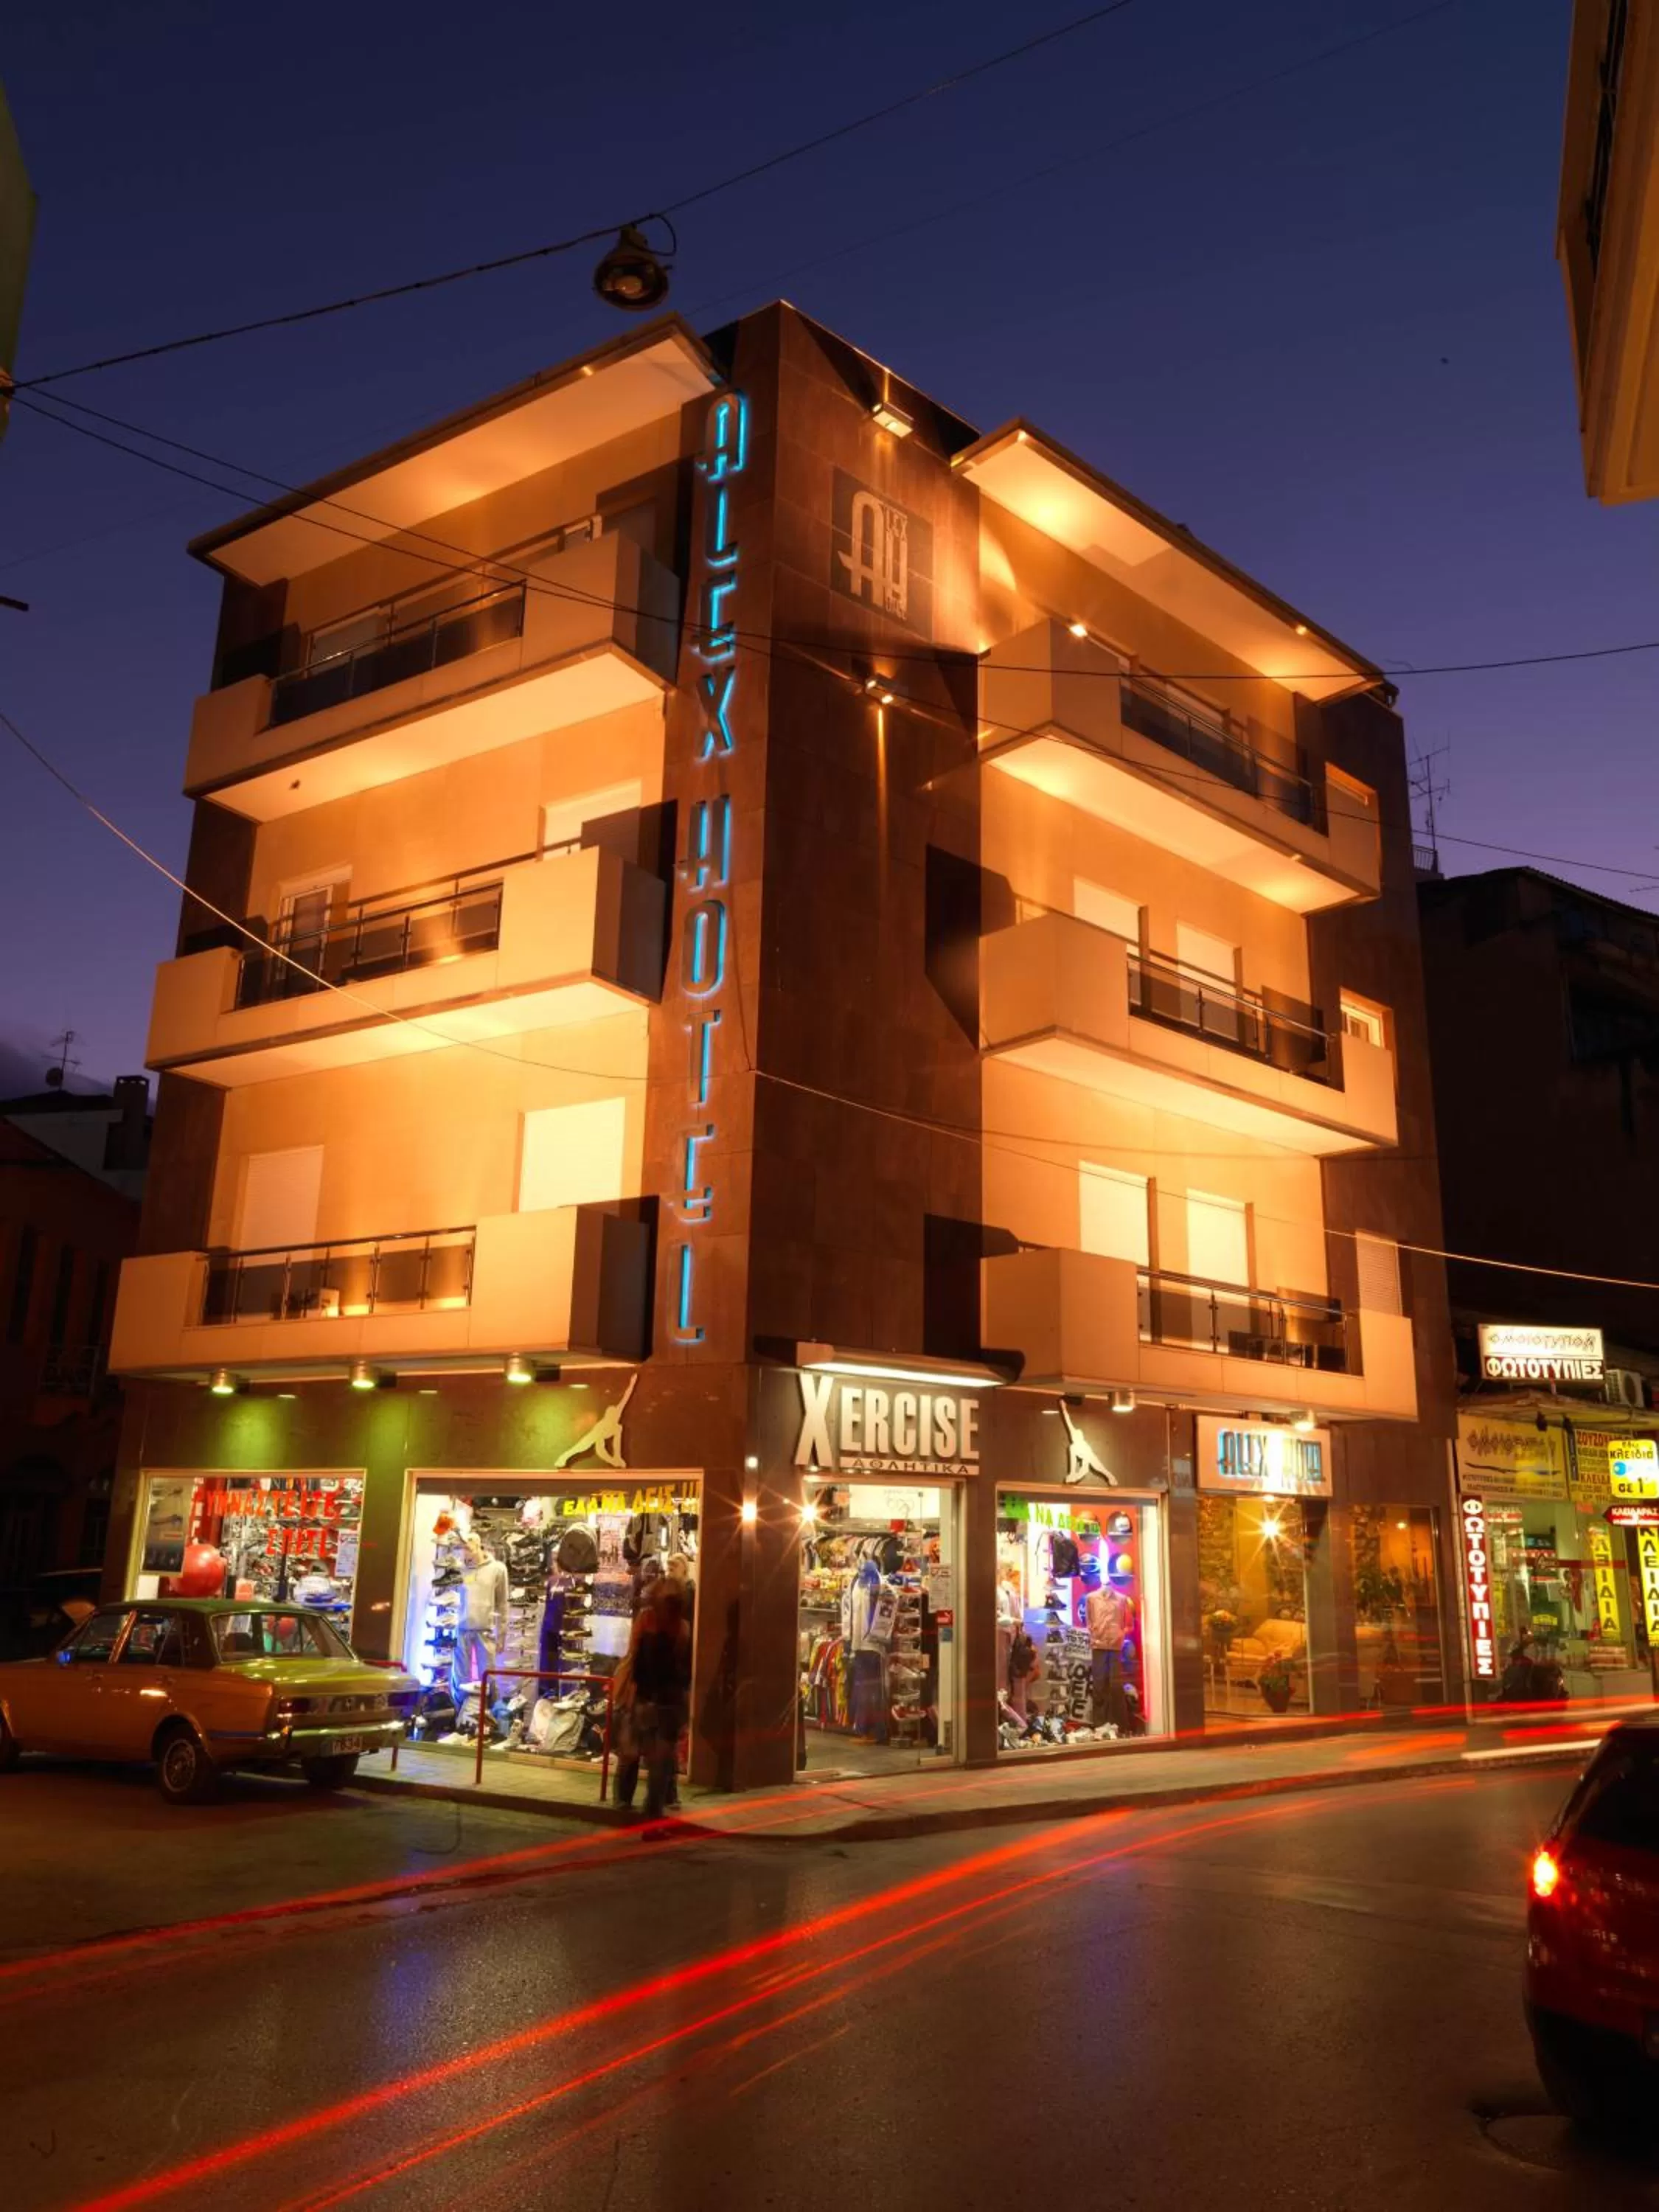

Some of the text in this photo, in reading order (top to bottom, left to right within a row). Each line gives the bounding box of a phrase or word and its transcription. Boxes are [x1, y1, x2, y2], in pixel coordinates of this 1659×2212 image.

[667, 793, 732, 1345] HOTEL
[1486, 1357, 1604, 1380] ΦΩΤΟΤΥΠΙΕΣ
[793, 1373, 980, 1467] XERCISE
[852, 1458, 969, 1475] ΑΘΛΗΤΙΚΑ
[1462, 1499, 1494, 1675] ΦΩΤΟΤΥΠΙΕΣ
